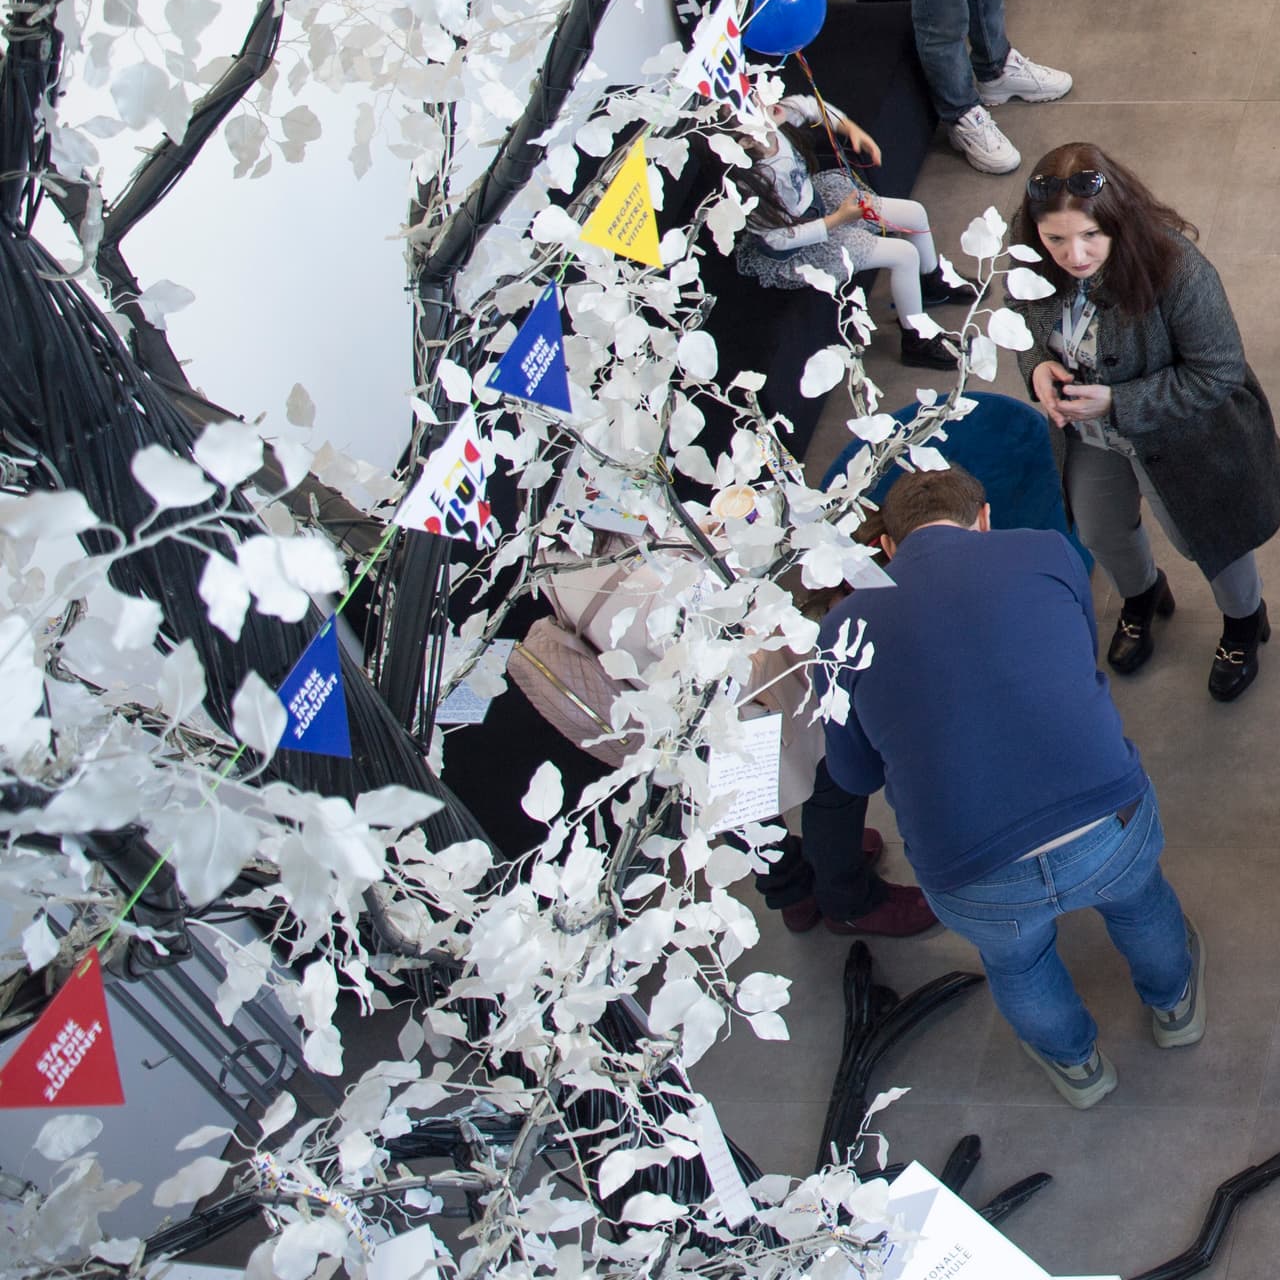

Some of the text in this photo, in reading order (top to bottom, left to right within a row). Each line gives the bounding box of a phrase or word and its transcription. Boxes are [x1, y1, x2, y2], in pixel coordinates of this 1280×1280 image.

[521, 334, 546, 372] STARK
[526, 341, 559, 397] ZUKUNFT
[289, 668, 321, 713] STARK
[292, 673, 339, 740] ZUKUNFT
[308, 679, 325, 699] DIE
[35, 1018, 81, 1074] STARK
[43, 1021, 104, 1102] ZUKUNFT
[62, 1027, 87, 1058] DIE
